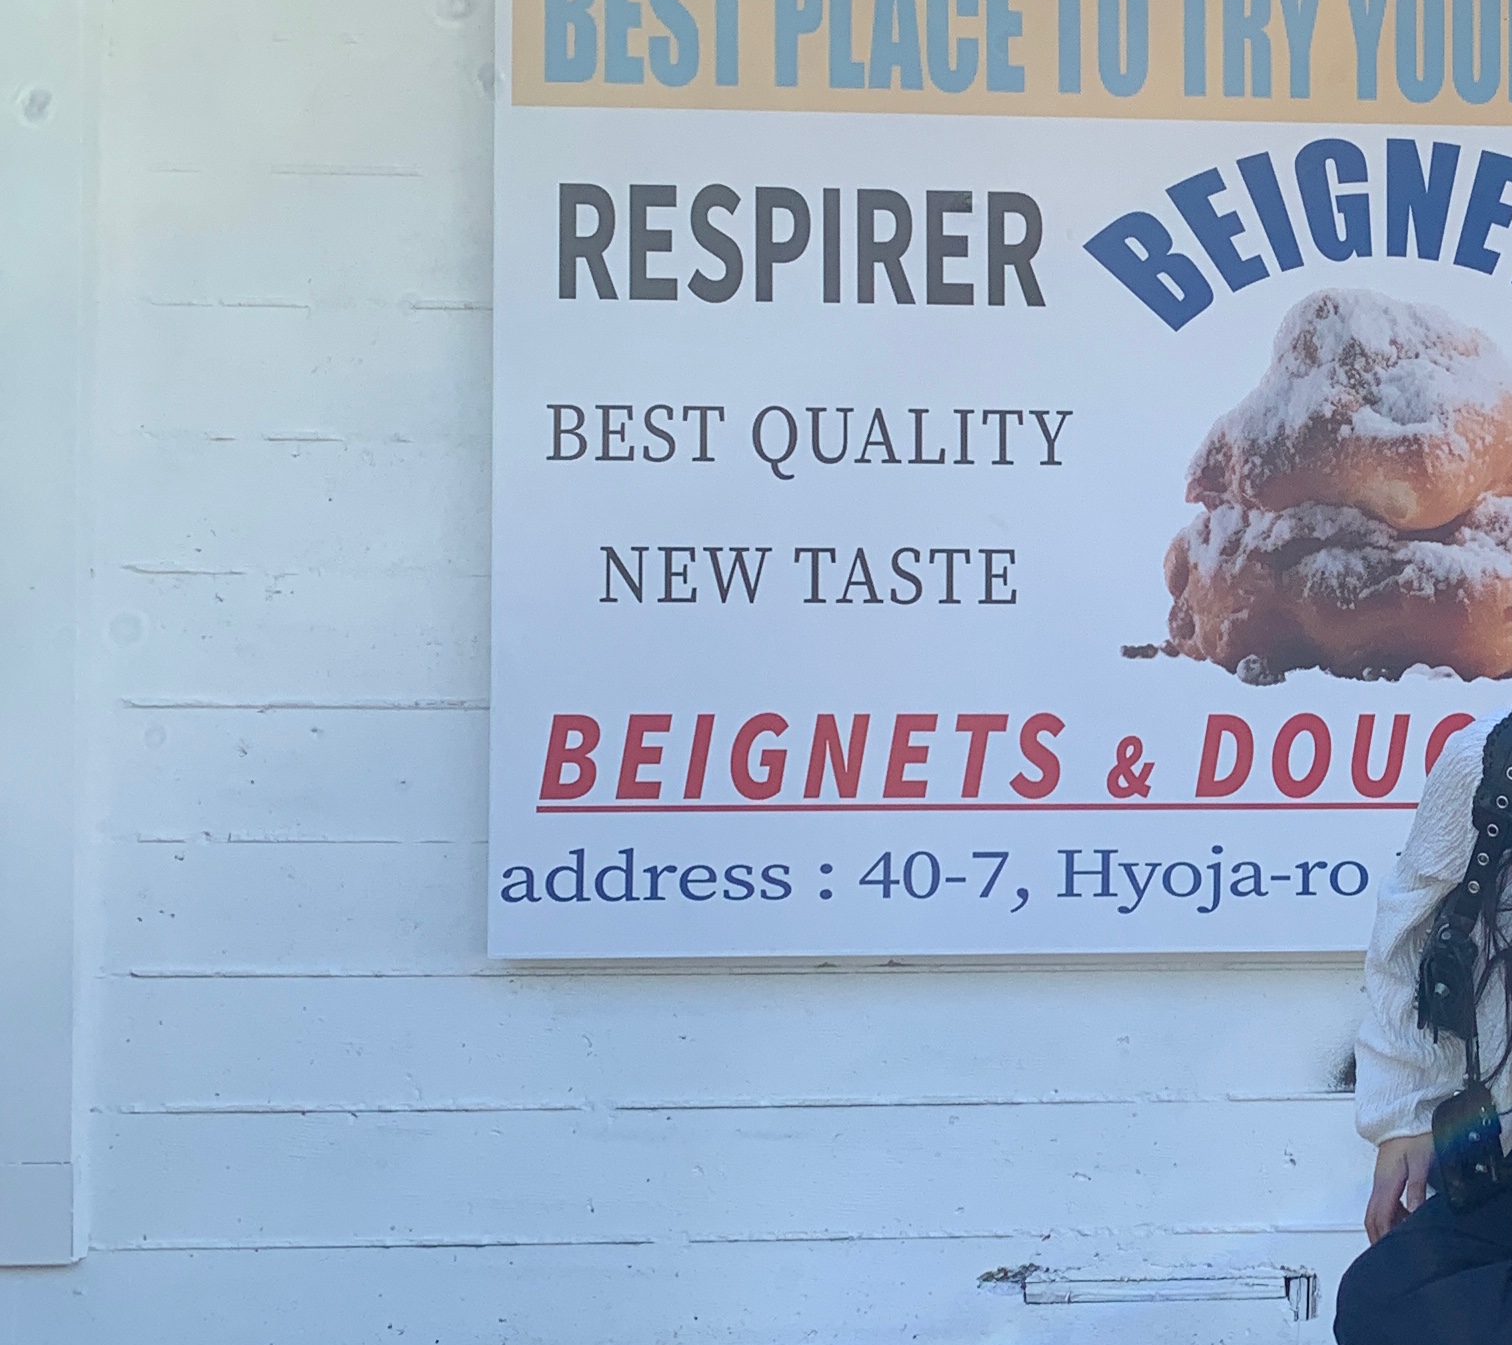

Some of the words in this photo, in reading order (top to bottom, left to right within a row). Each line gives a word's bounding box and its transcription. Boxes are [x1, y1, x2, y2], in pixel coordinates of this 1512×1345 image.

[557, 181, 1048, 308] RESPIRER
[545, 402, 726, 463] BEST
[750, 404, 1074, 481] QUALITY
[598, 546, 773, 605] NEW
[793, 546, 1018, 606] TASTE
[537, 711, 1067, 802] BEIGNETS
[1105, 734, 1156, 800] &
[498, 846, 794, 906] address
[857, 849, 1032, 914] 40-7,
[1056, 843, 1370, 916] Hyoja-ro
